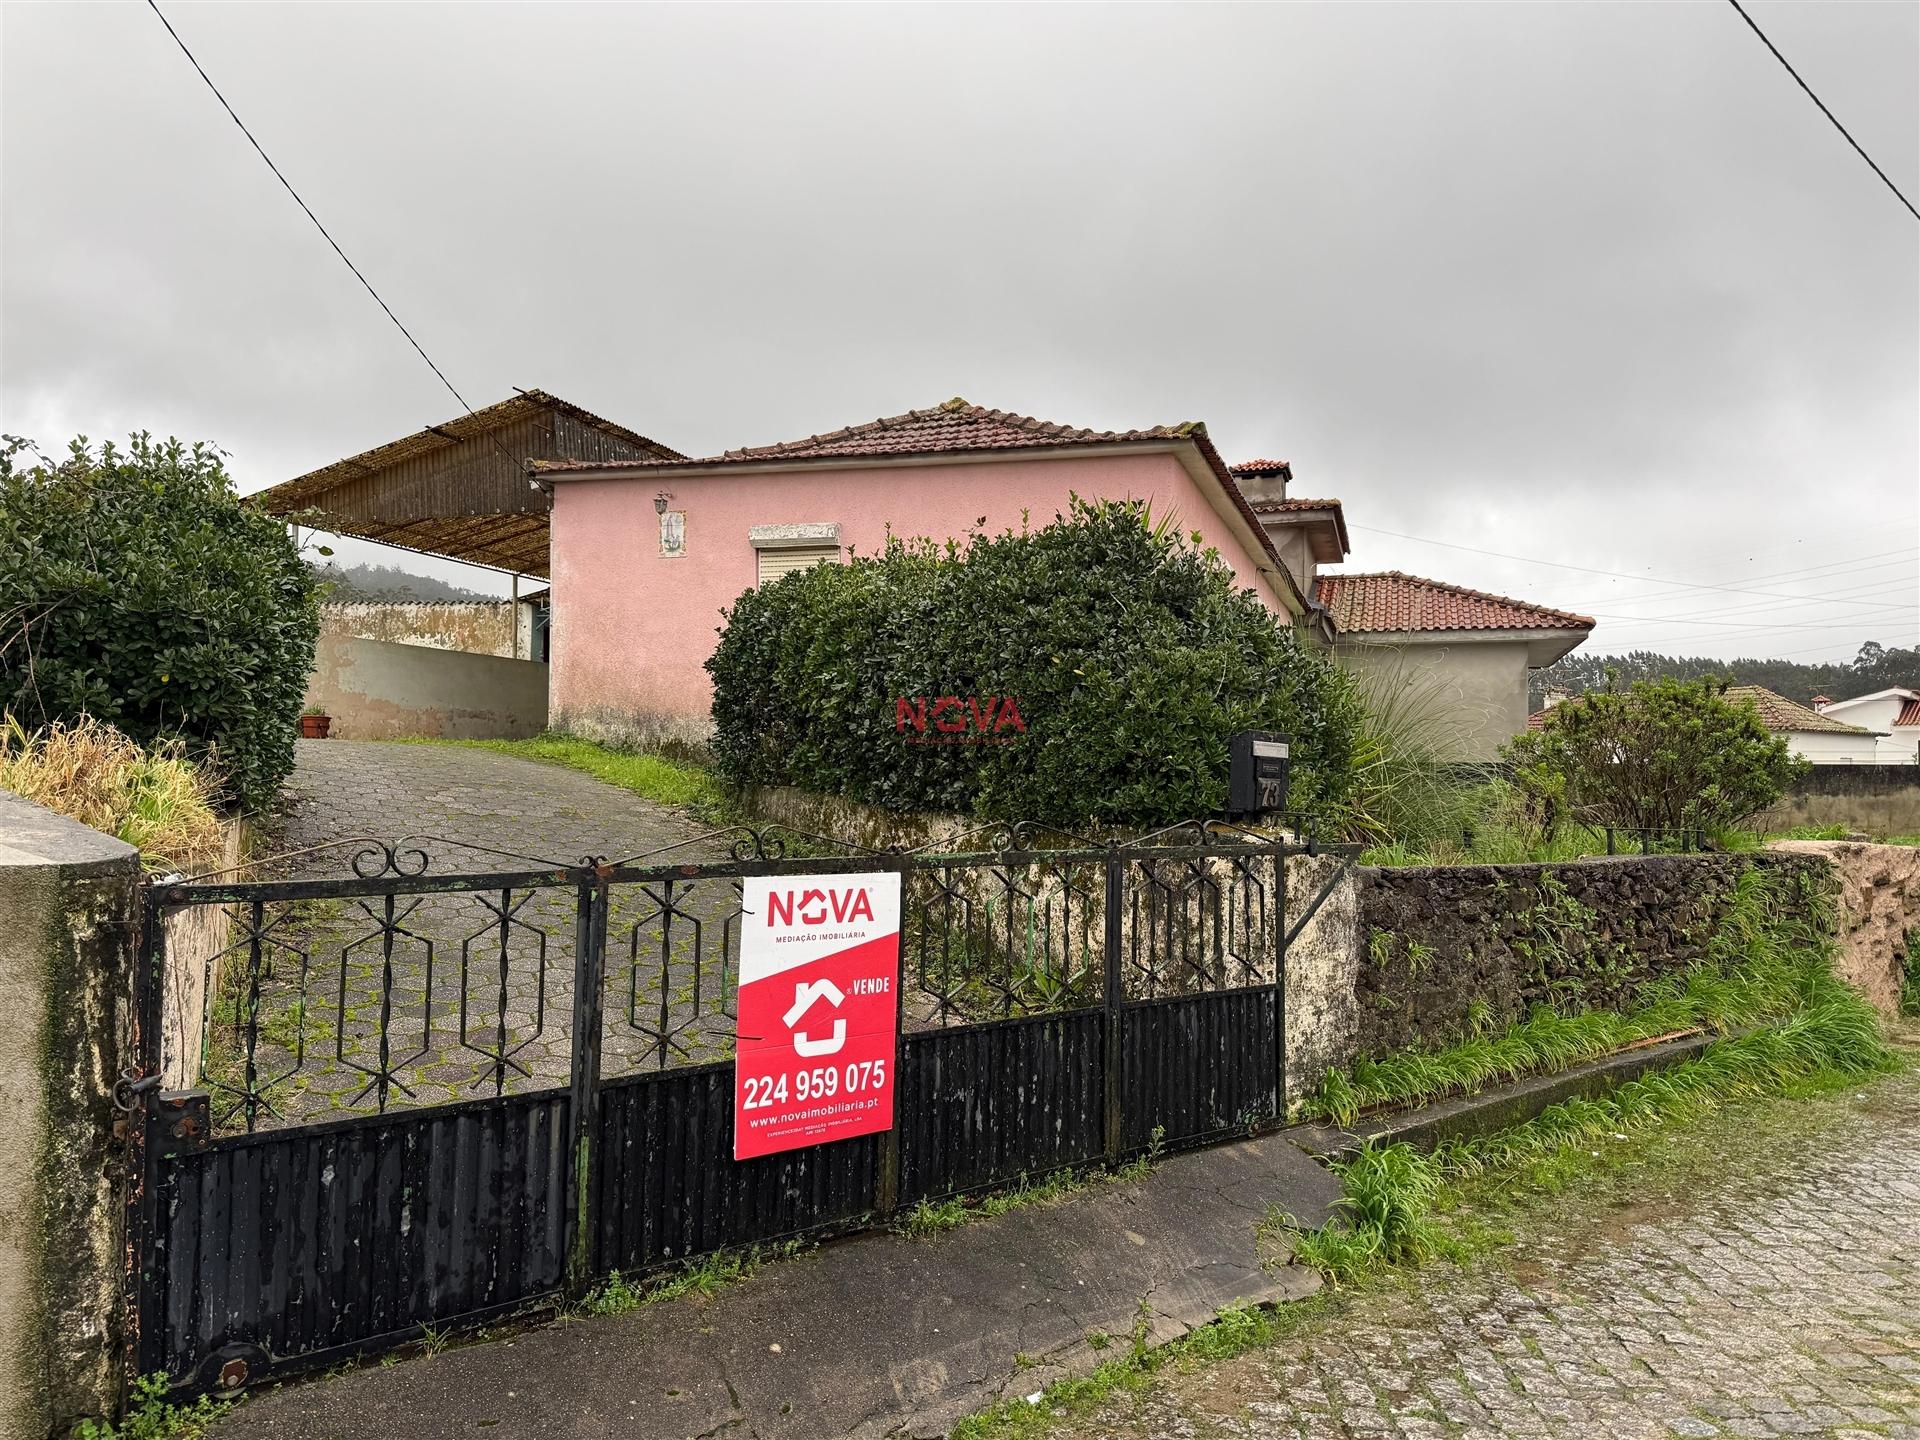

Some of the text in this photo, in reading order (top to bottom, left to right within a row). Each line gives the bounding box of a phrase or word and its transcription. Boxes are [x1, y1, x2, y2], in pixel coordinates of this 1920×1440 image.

[767, 888, 874, 927] NOVA
[776, 931, 866, 943] MEDIAÇÃO IMOBILIÁRIA
[853, 977, 889, 995] VENDE
[743, 1059, 885, 1110] 224 959 075
[750, 1097, 878, 1128] www.novaimobiliaria.pt
